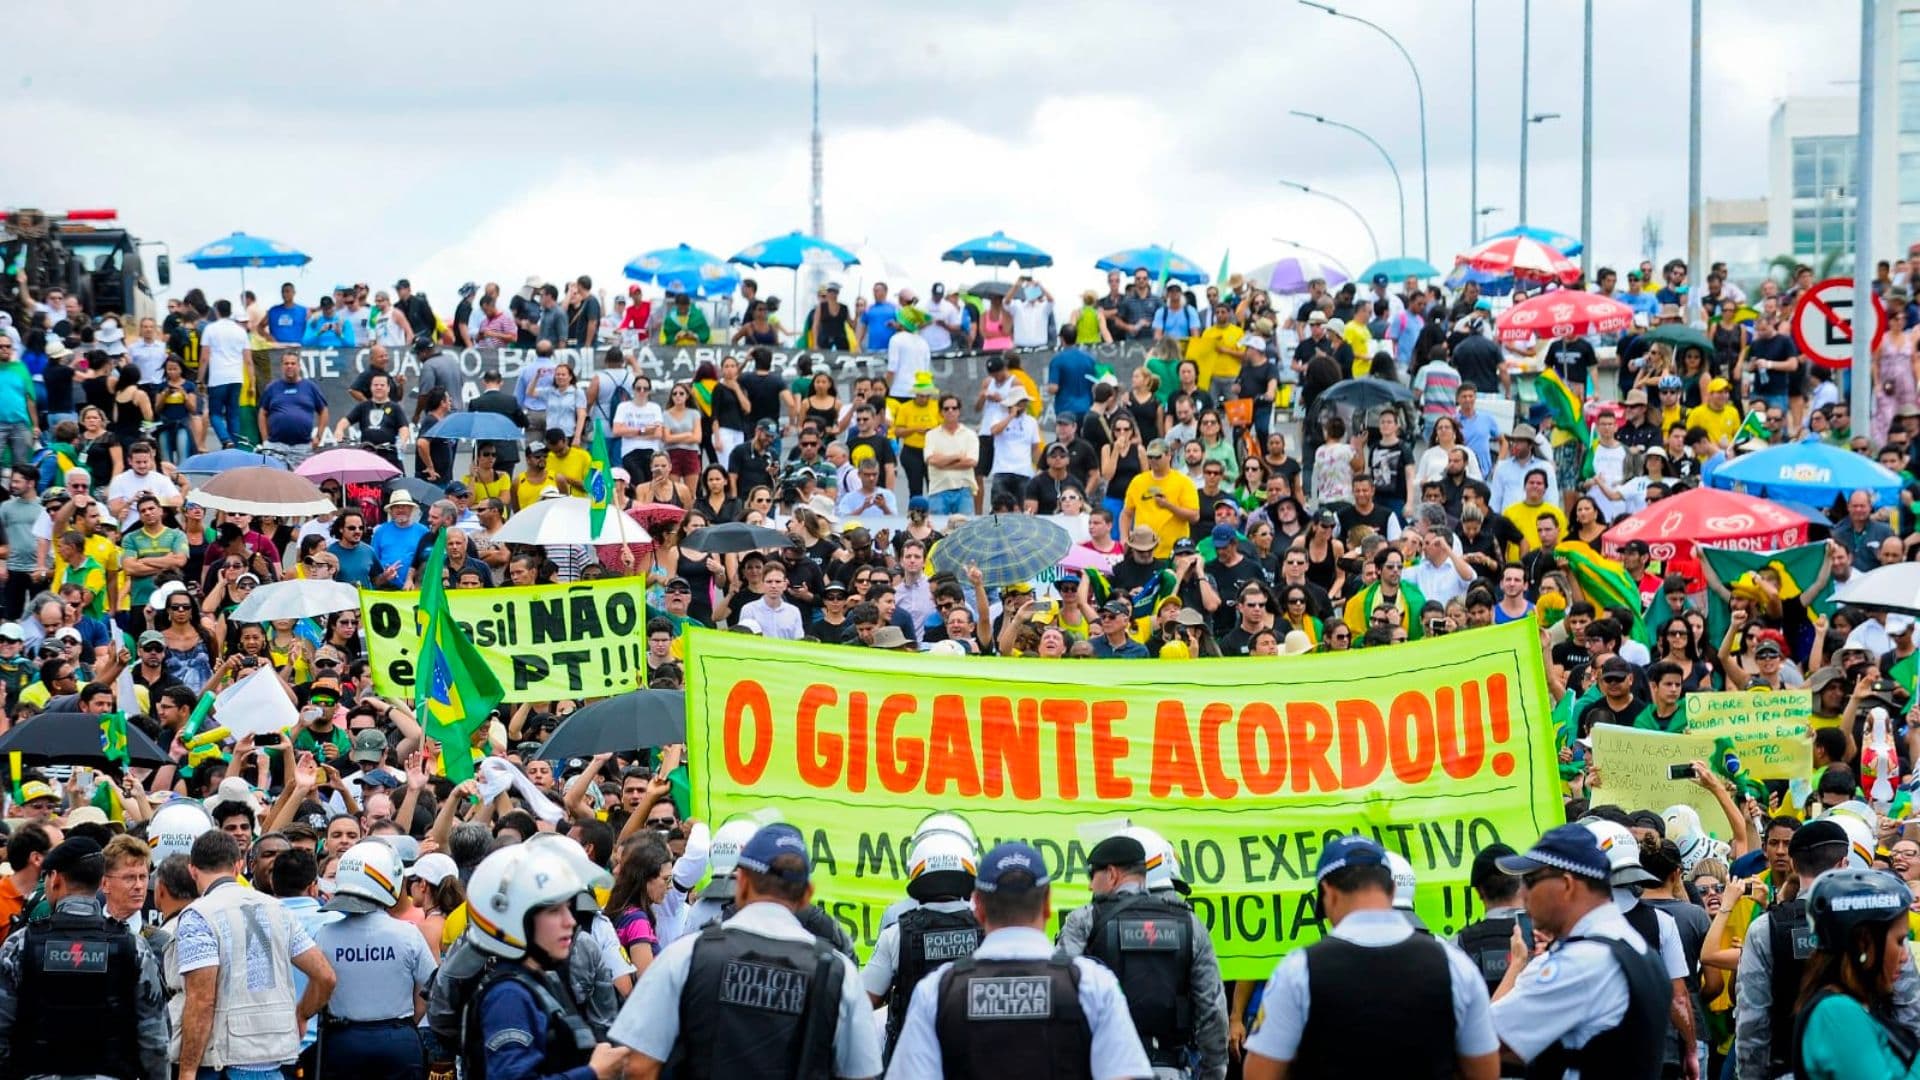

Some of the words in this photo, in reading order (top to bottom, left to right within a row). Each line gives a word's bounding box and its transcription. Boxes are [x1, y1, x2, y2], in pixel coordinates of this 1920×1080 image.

[369, 602, 401, 638] O
[528, 585, 638, 645] NÃO
[388, 648, 416, 687] é
[723, 679, 773, 787] O
[796, 684, 1133, 801] GIGANTE
[1150, 672, 1516, 801] ACORDOU!
[1831, 893, 1901, 912] REPORTAGEM
[335, 943, 396, 963] POLÍCIA
[722, 981, 804, 1013] MILITAR
[972, 979, 1047, 1000] POLÍCIA
[972, 998, 1046, 1014] MILITAR
